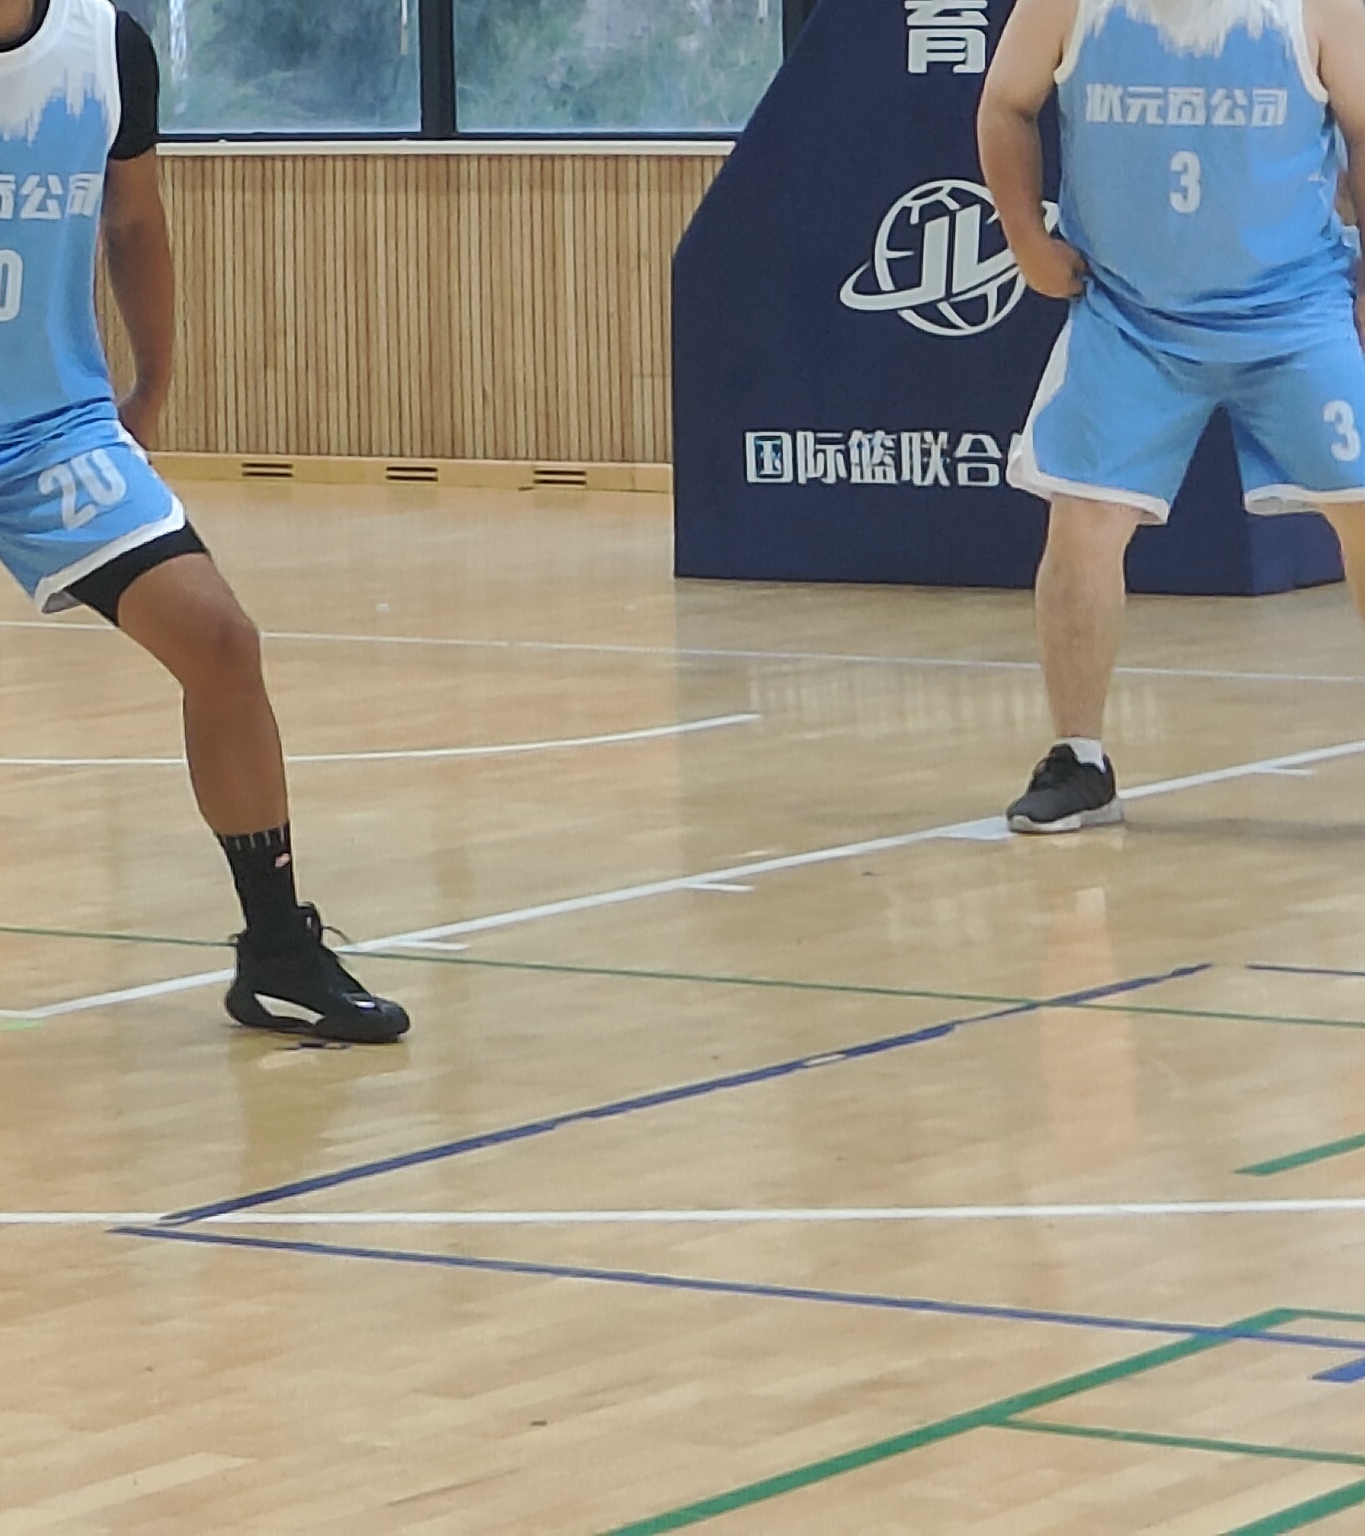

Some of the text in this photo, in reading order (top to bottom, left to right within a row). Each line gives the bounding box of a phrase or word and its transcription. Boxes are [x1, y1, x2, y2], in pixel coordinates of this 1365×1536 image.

[1169, 150, 1202, 214] 3
[744, 428, 1024, 488] 国际篮联合
[1322, 399, 1362, 463] 3
[37, 448, 128, 531] 20
